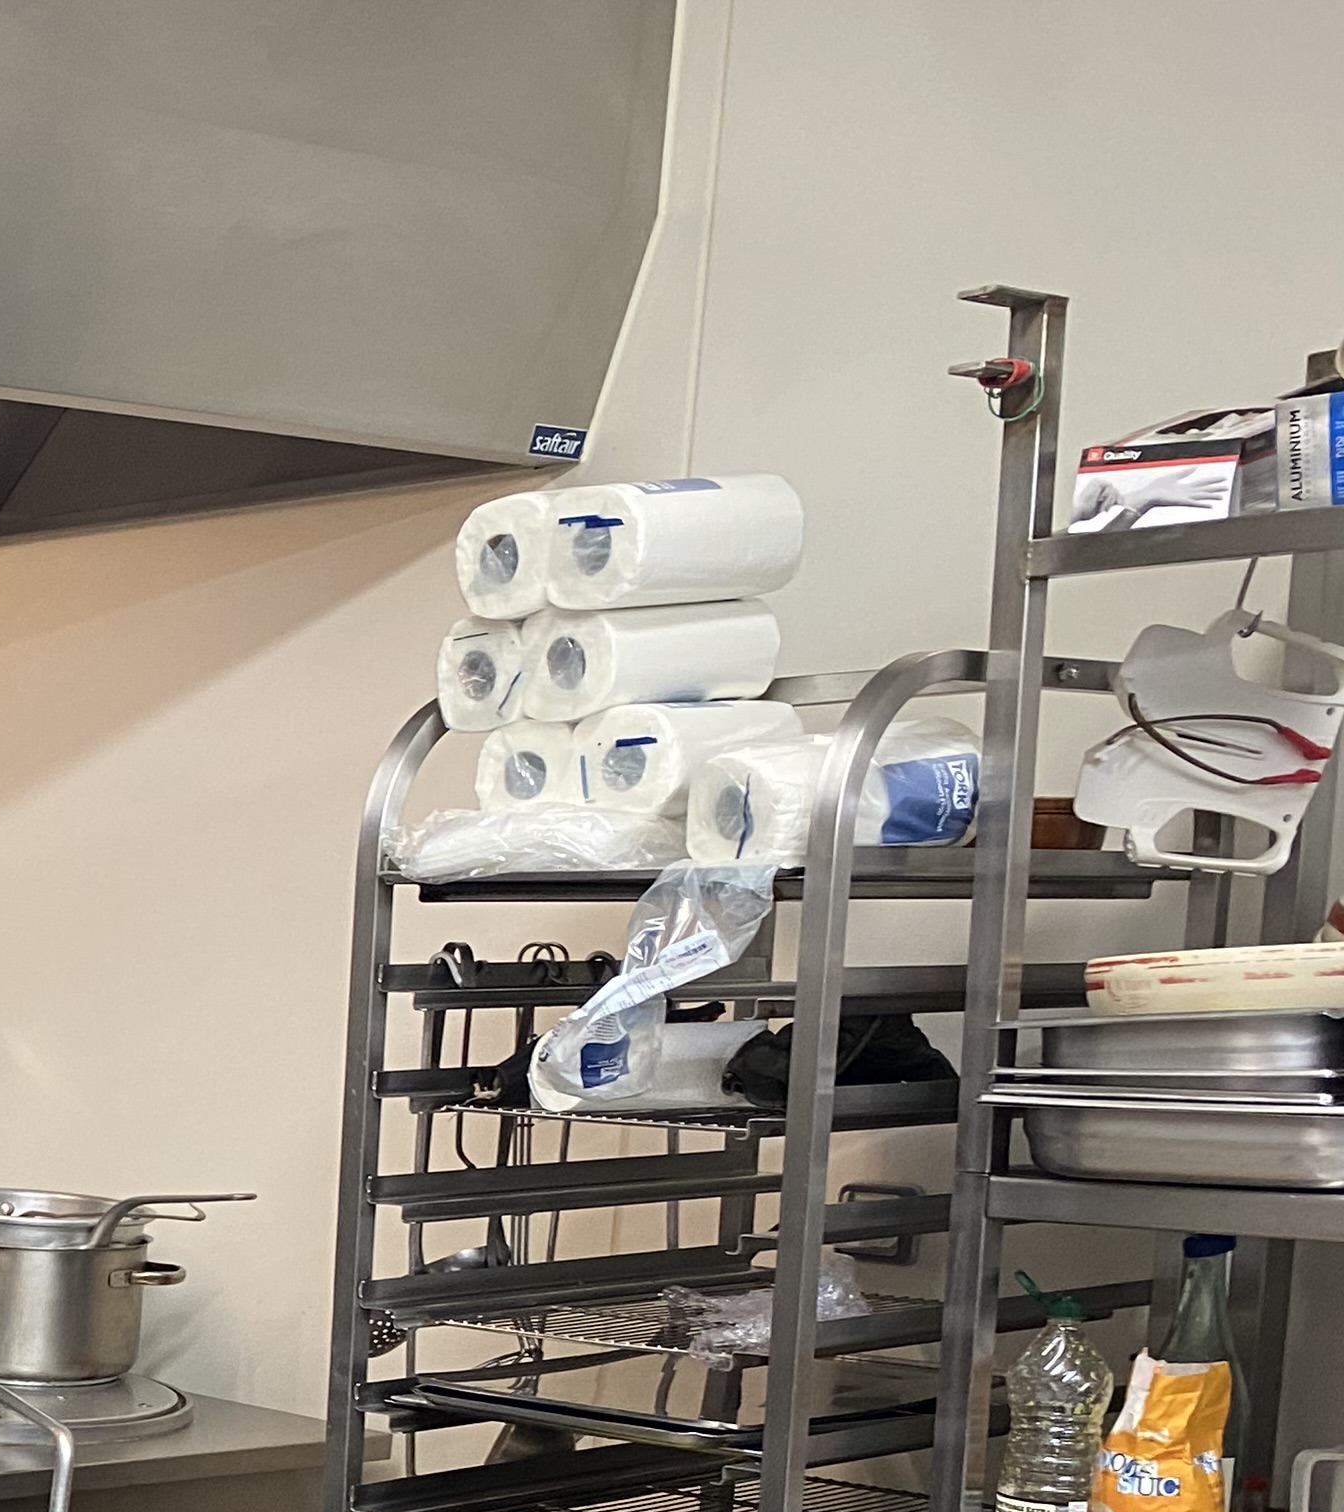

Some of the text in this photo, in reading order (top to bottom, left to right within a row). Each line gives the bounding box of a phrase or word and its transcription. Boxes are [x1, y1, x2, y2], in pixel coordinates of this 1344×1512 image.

[532, 431, 581, 455] saftair
[1102, 449, 1142, 462] Quality
[1289, 408, 1302, 502] ALUMINIUM
[951, 762, 969, 807] TORK
